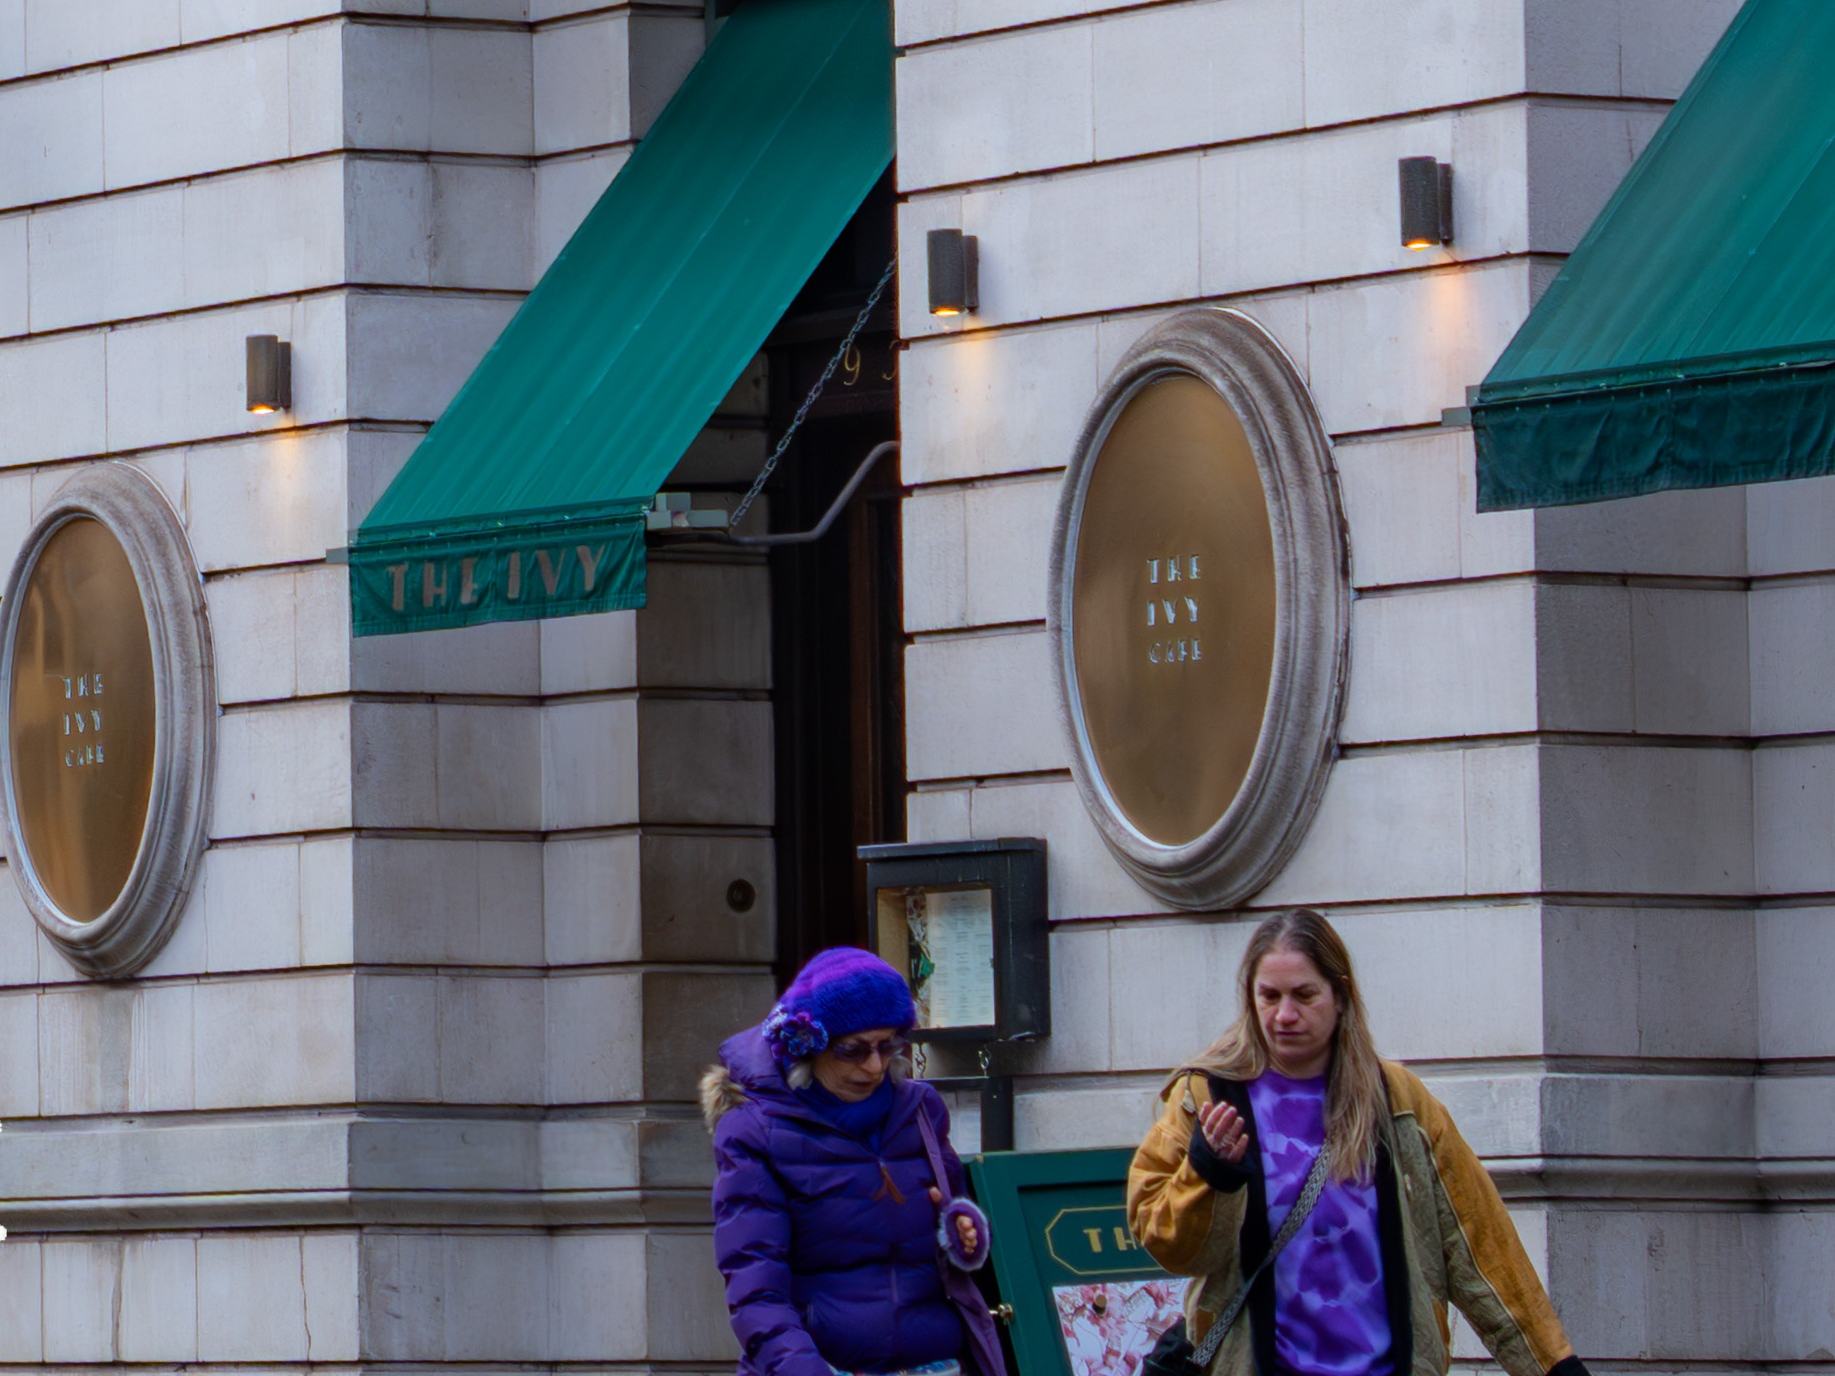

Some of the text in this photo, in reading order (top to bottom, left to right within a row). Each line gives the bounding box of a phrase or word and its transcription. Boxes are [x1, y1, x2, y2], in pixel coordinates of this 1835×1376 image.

[387, 545, 606, 611] THE IVY
[1146, 554, 1201, 584] THE
[1146, 596, 1199, 626] IVY
[1148, 639, 1203, 664] CAFE
[62, 673, 104, 699] THE
[63, 710, 102, 736] IVY
